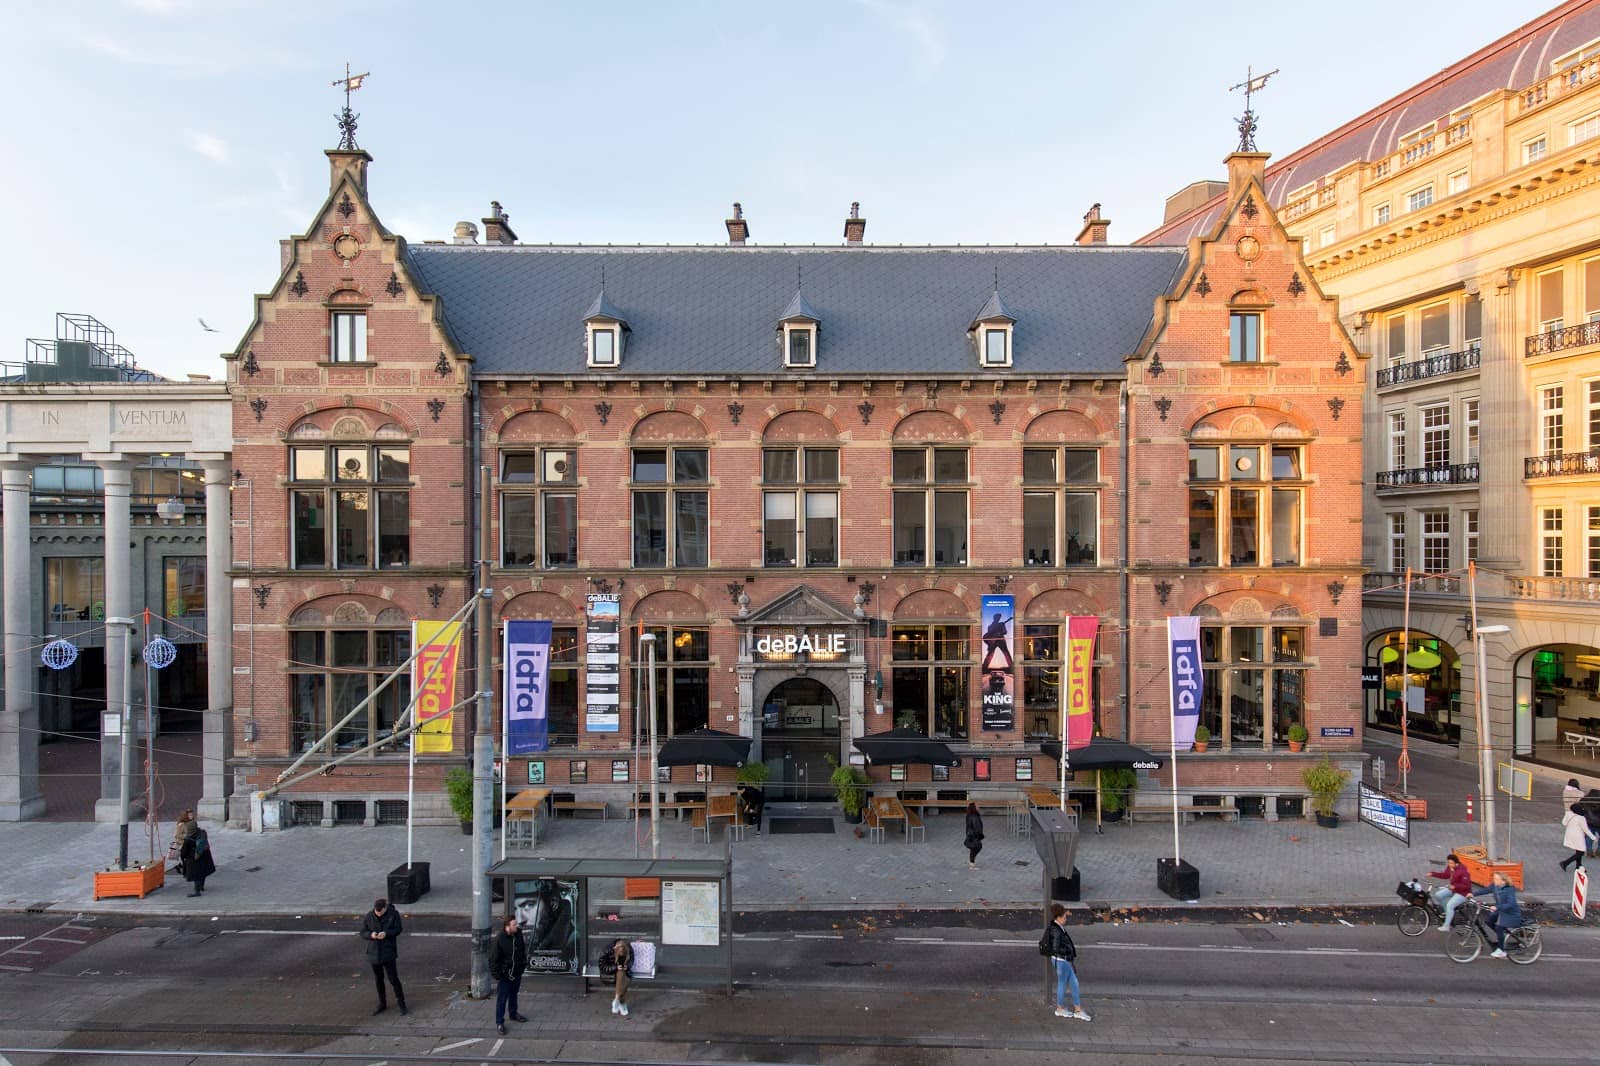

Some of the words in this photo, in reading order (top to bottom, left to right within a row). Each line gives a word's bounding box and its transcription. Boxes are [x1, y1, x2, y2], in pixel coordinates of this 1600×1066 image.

[42, 410, 60, 425] IN
[119, 410, 186, 425] VENTUM
[587, 594, 619, 602] deBALIE
[756, 633, 847, 653] deBALIE
[421, 651, 450, 713] idfa
[515, 650, 541, 713] idfa
[1175, 646, 1198, 710] idfa
[983, 694, 1013, 705] KING
[1132, 761, 1159, 769] debalie
